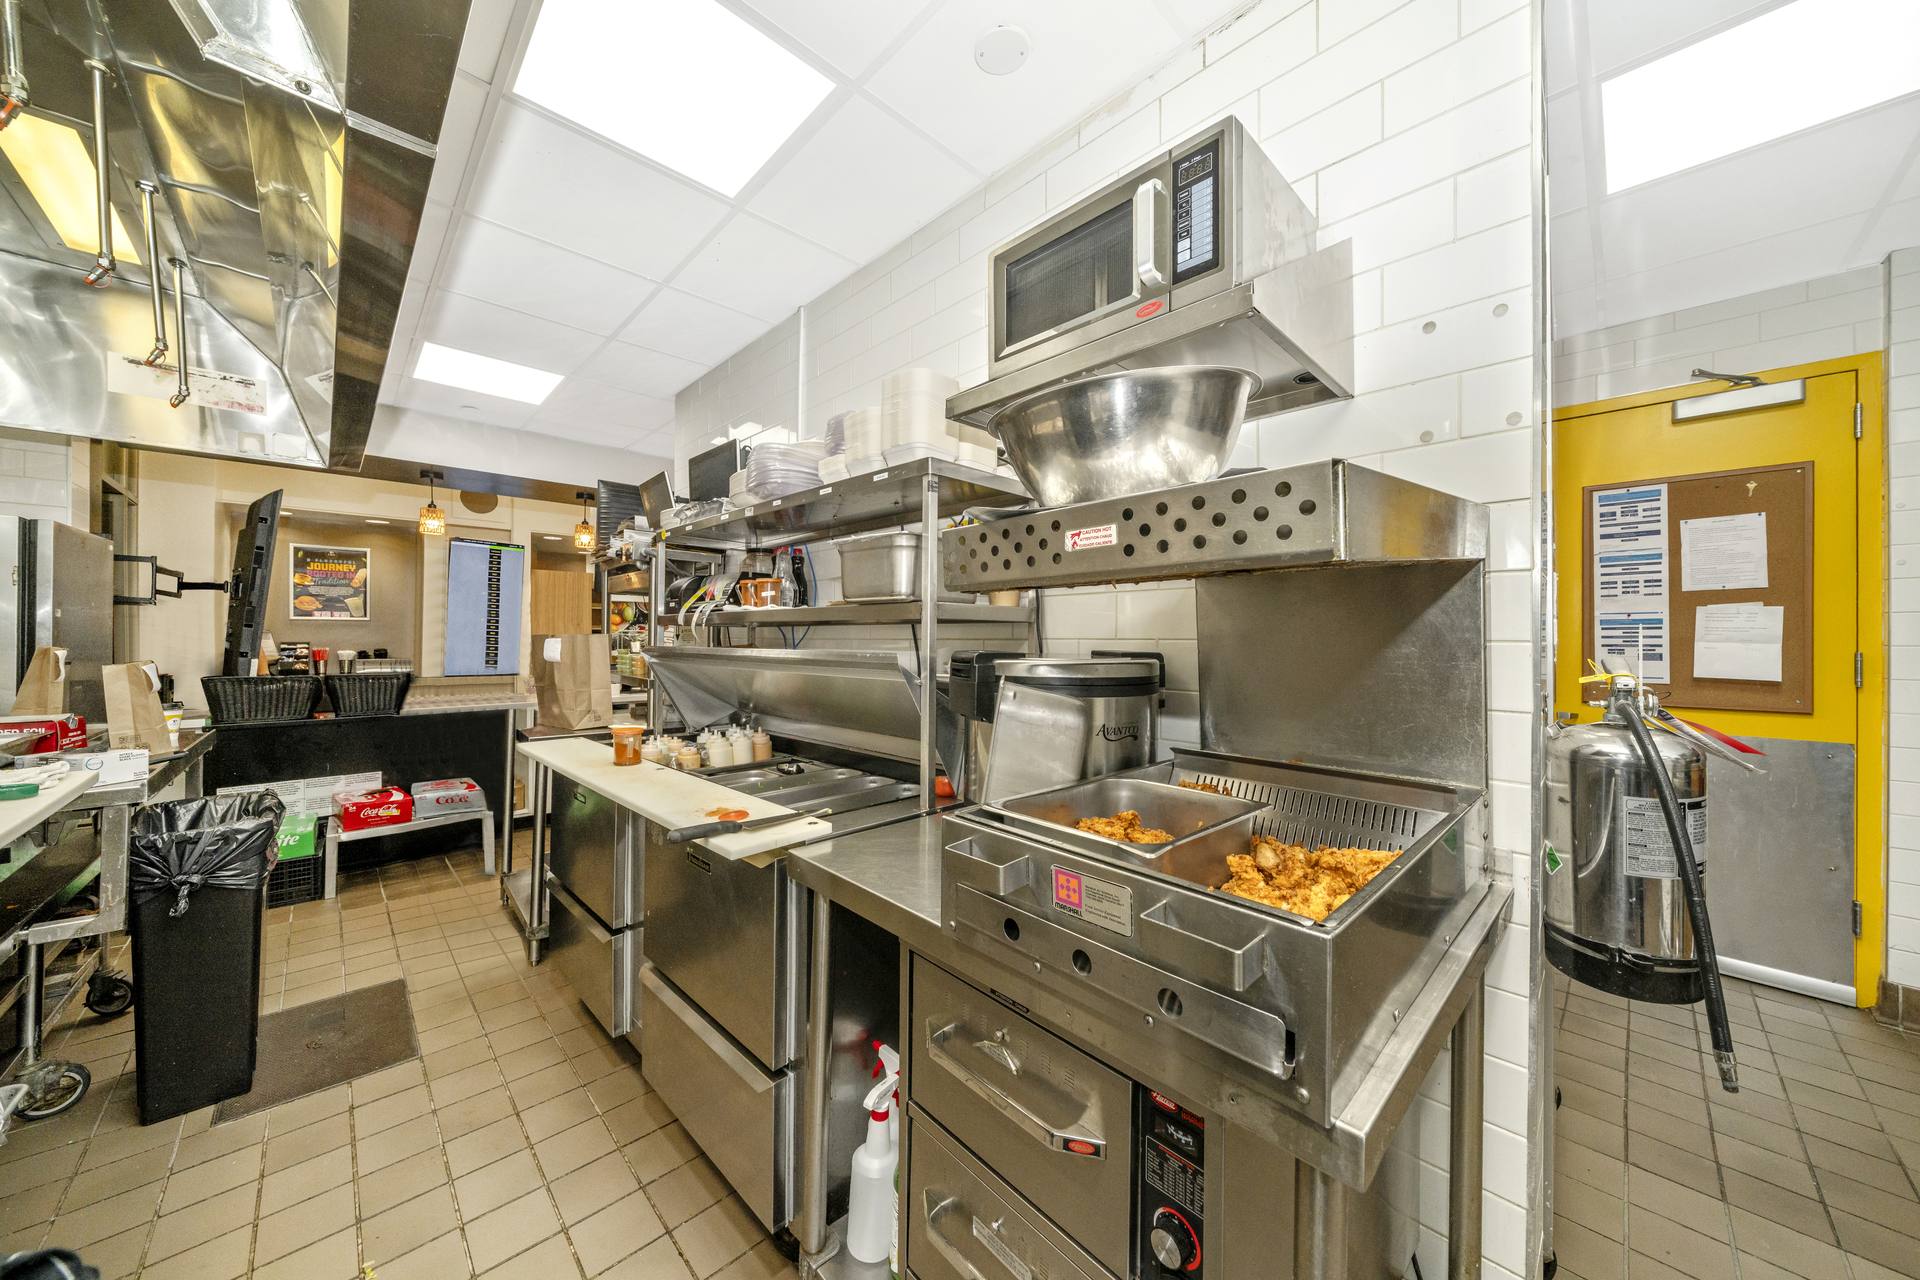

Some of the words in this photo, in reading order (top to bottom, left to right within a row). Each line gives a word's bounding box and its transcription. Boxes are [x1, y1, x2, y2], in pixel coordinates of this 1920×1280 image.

[307, 562, 356, 572] JOURNEY
[307, 570, 344, 578] ROOTED
[278, 833, 299, 847] ite
